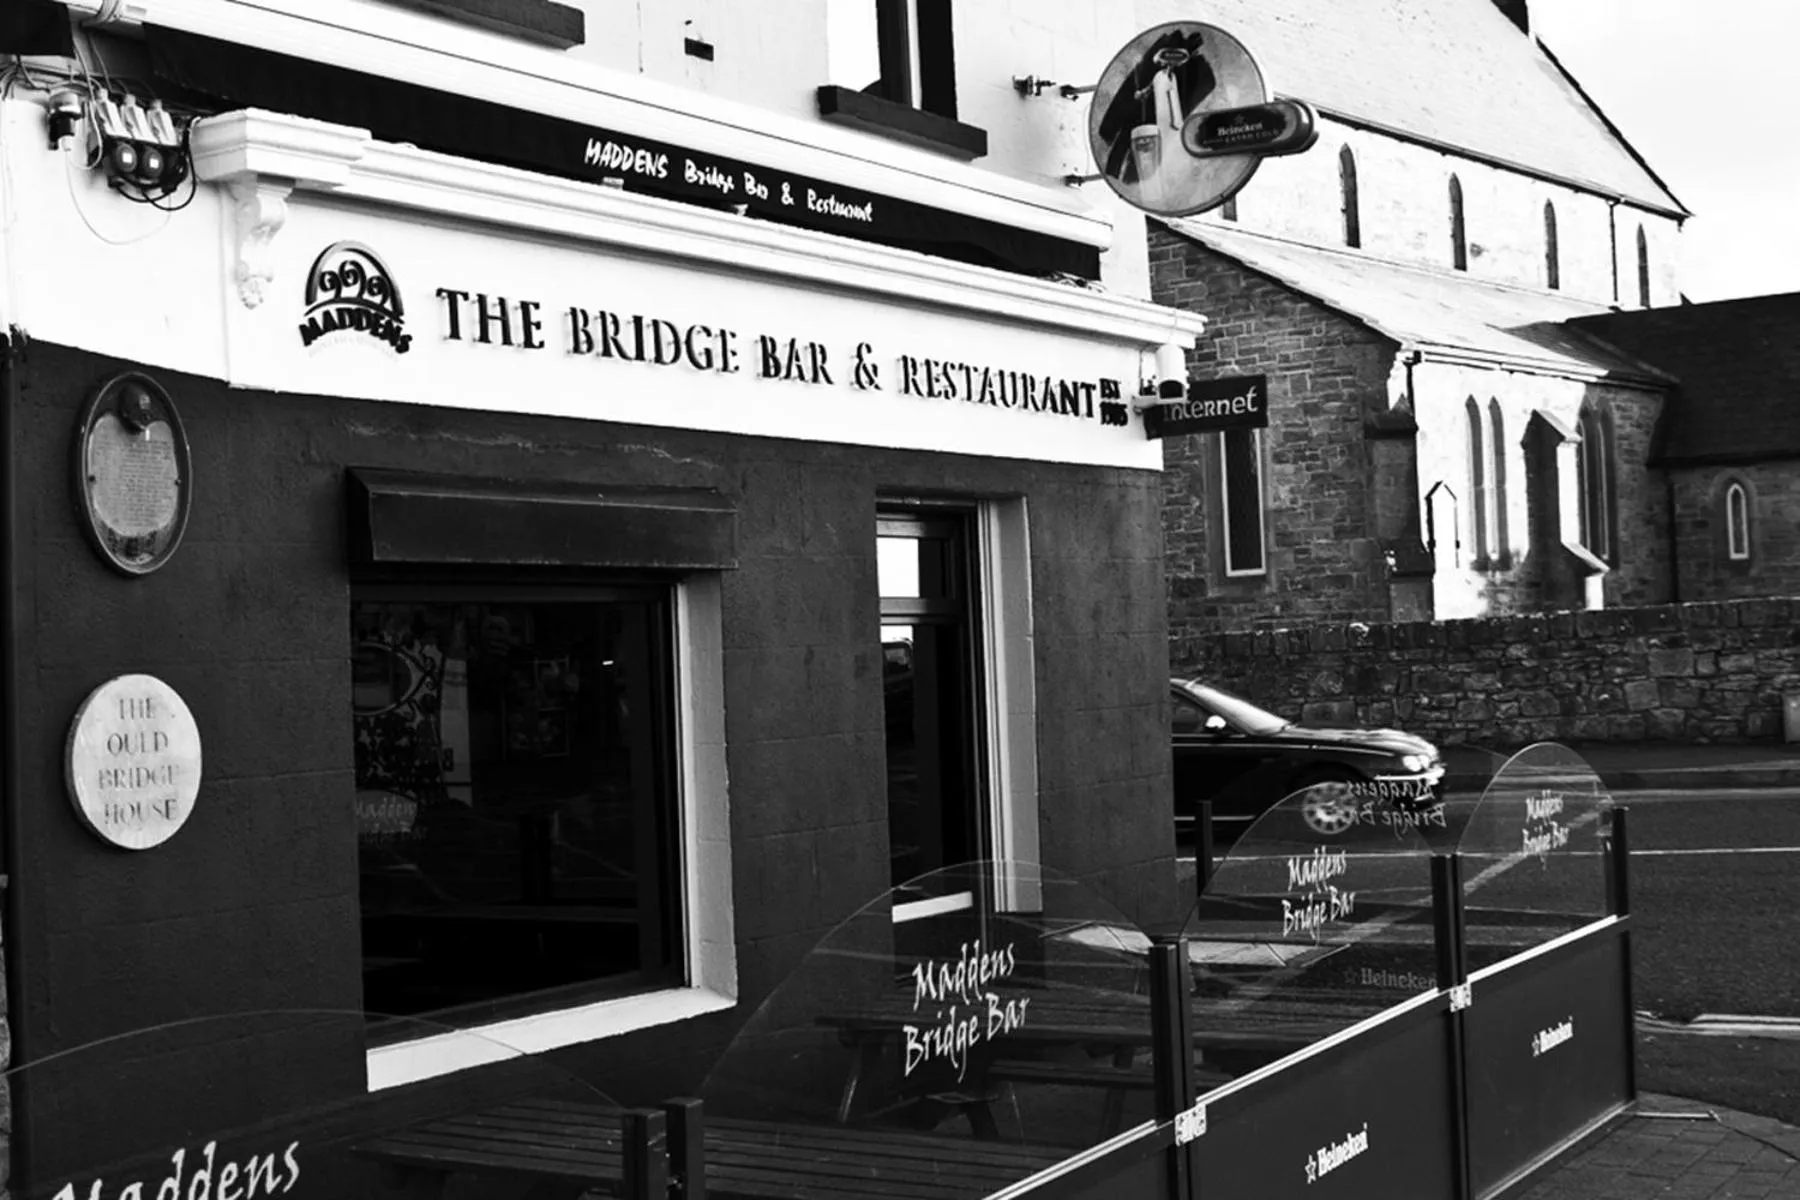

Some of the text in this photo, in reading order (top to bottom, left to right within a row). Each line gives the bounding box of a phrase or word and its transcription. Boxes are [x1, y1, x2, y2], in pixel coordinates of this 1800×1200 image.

[584, 137, 669, 178] MADDENS
[685, 158, 734, 194] Bridge
[781, 182, 795, 206] &
[298, 306, 413, 354] MADDENS
[436, 287, 545, 349] THE
[565, 306, 740, 374] BRIDGE
[756, 334, 834, 385] BAR
[852, 341, 882, 391] &
[897, 354, 1097, 418] RESTAURANT
[117, 696, 157, 721] THE
[107, 731, 169, 756] OULD
[98, 764, 180, 790] BRIDGE
[104, 798, 178, 826] HOUSE
[1287, 846, 1347, 893] Maddens
[1281, 885, 1356, 946] Bridge Bar
[912, 939, 1016, 1012] Maddens
[902, 992, 1031, 1083] Bridge Bar
[1316, 1124, 1369, 1178] Heineken
